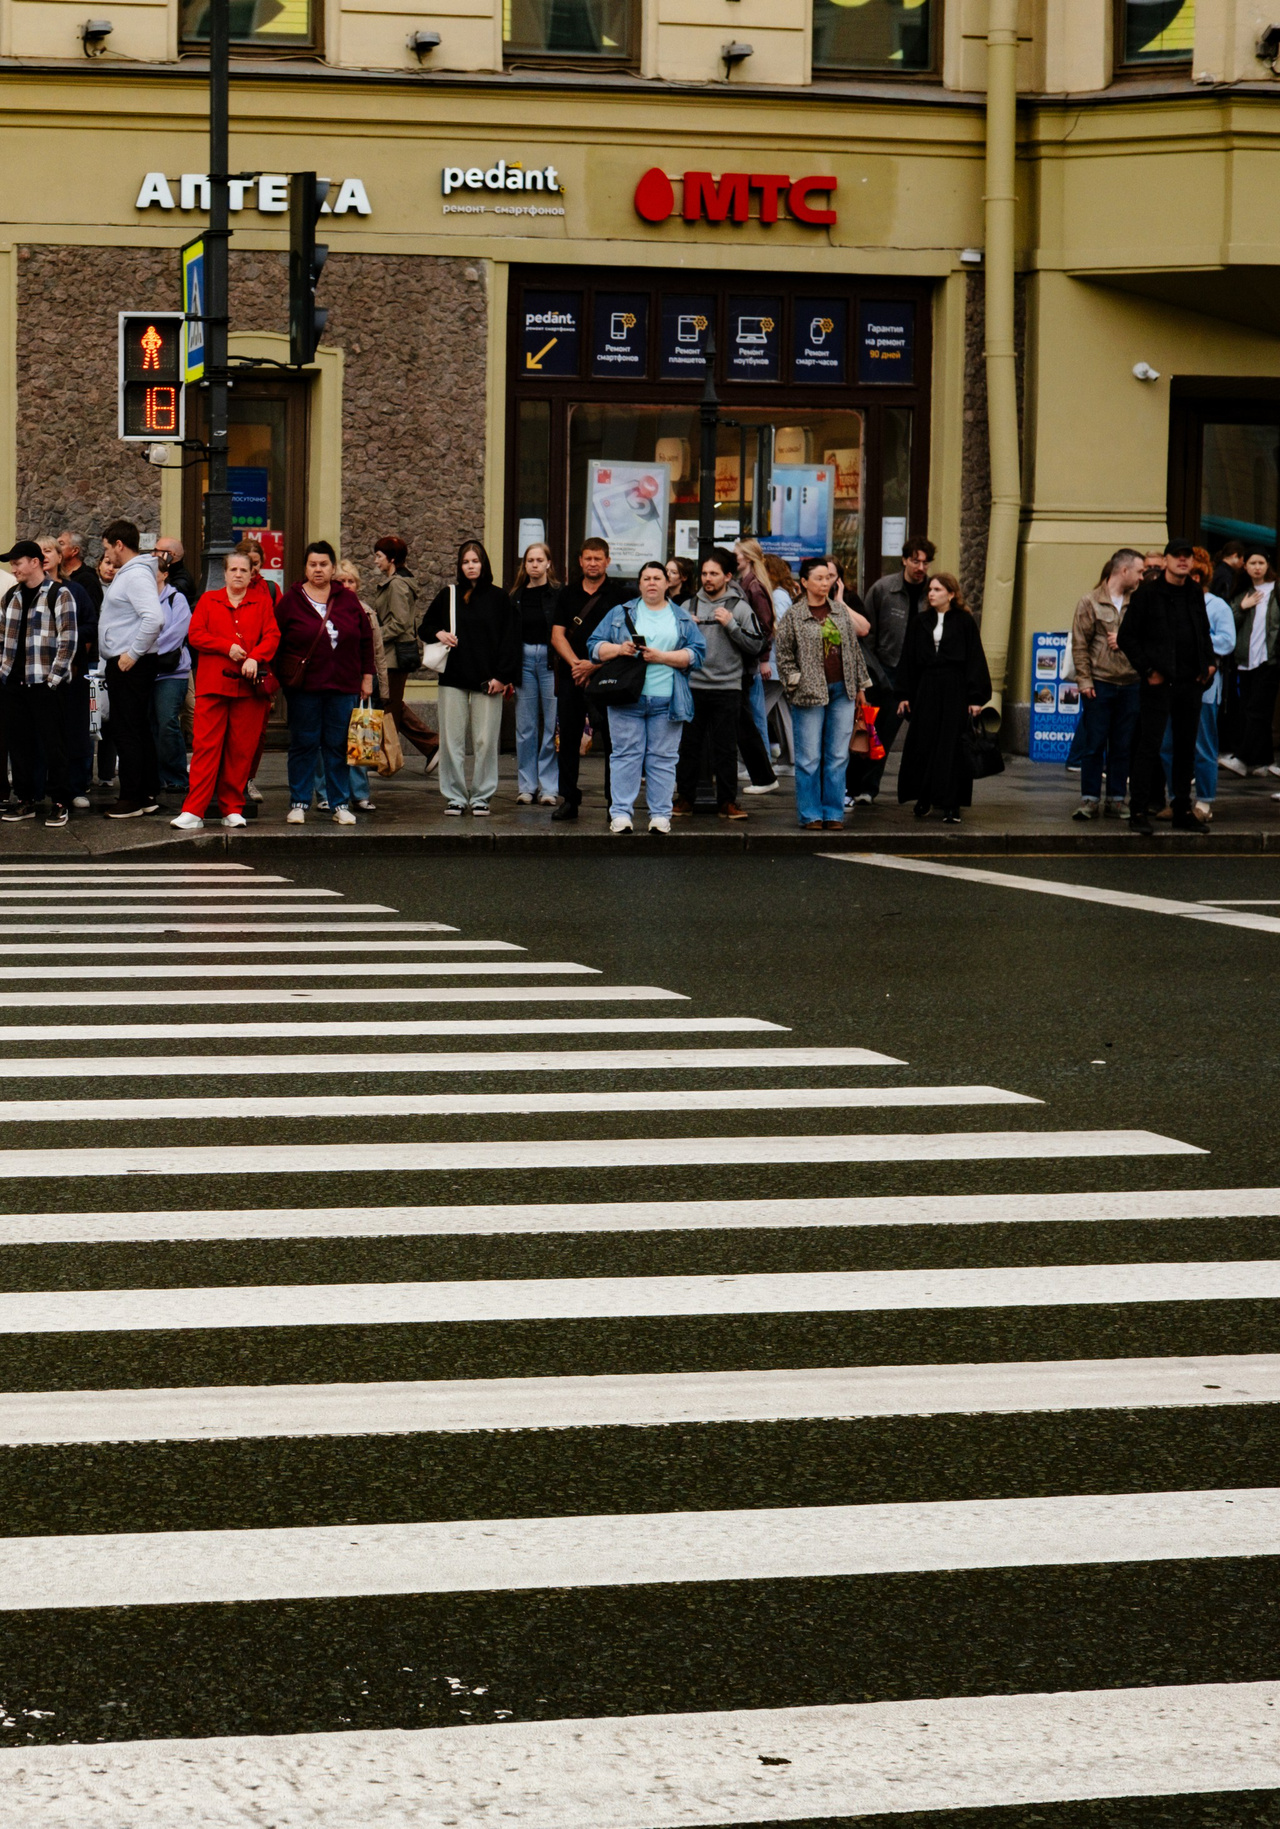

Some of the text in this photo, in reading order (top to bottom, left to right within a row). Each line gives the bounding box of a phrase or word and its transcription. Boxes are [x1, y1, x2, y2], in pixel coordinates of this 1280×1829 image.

[135, 172, 373, 215] АПТЕА
[683, 171, 838, 225] МТС
[442, 204, 565, 217] ремонт смартфонов
[867, 323, 904, 334] Гарантия
[865, 338, 906, 347] на ремонт
[605, 344, 631, 353] Ремонт
[675, 347, 700, 355] Ремонт
[738, 347, 764, 356] Ремонт
[804, 348, 829, 357] Ремонт
[597, 354, 639, 362] смартфонов
[869, 350, 901, 359] 90 дней
[146, 387, 175, 430] 18
[232, 495, 266, 503] ЛОСУТОЧНО
[1037, 636, 1067, 646] ЭКСК
[1034, 714, 1075, 724] КАРЕЛИЯ
